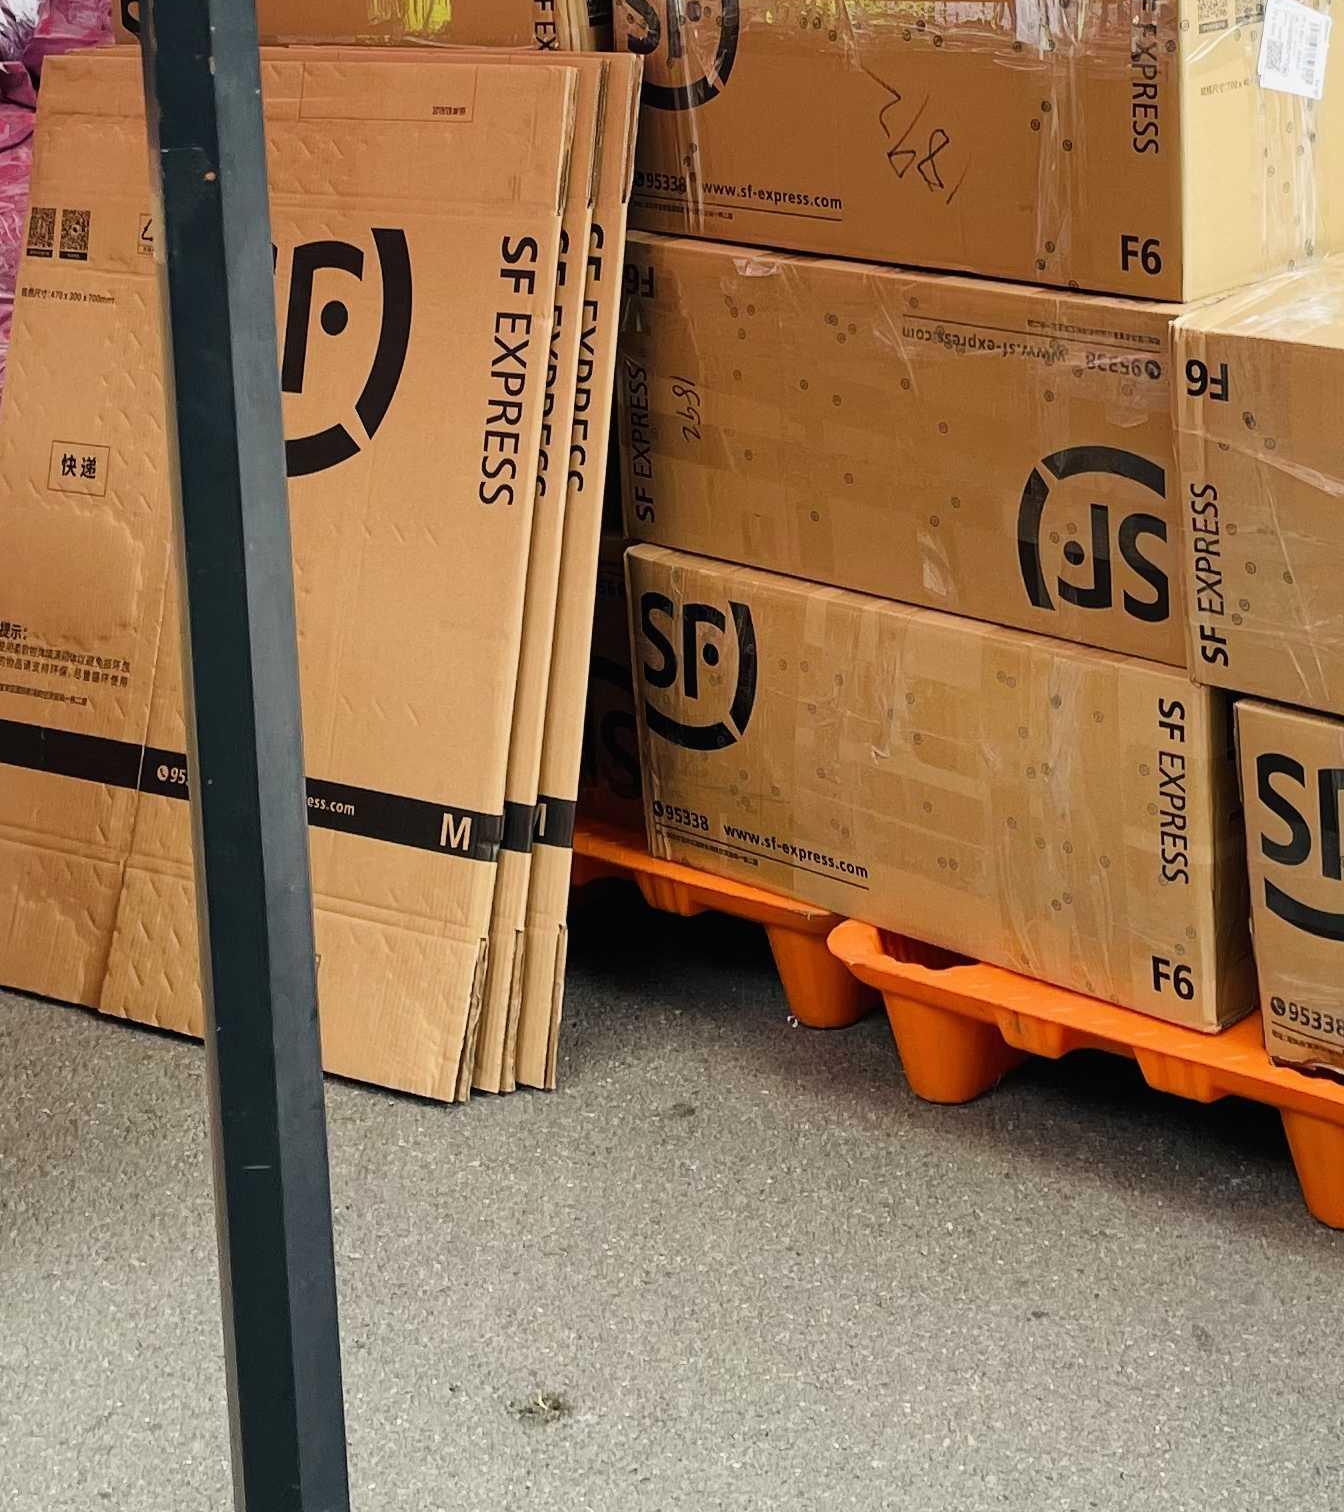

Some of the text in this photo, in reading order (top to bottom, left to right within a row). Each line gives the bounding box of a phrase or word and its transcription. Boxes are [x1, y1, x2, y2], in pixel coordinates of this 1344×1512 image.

[1130, 21, 1159, 156] EXPRESS
[703, 179, 843, 211] www.sf-express.com
[1119, 235, 1163, 276] F6
[479, 235, 539, 506] SF EXPRESS
[1185, 359, 1230, 403] F6
[60, 451, 98, 483] 快递
[629, 365, 656, 525] SF EXPRESS
[1058, 504, 1171, 623] SF
[1192, 483, 1229, 667] SF EXPRESS
[640, 591, 726, 699] SF
[439, 812, 473, 852] M
[1158, 698, 1190, 886] SF EXPRESS
[665, 803, 869, 881] 95338 www.sf-express.com
[1151, 956, 1196, 1001] F6
